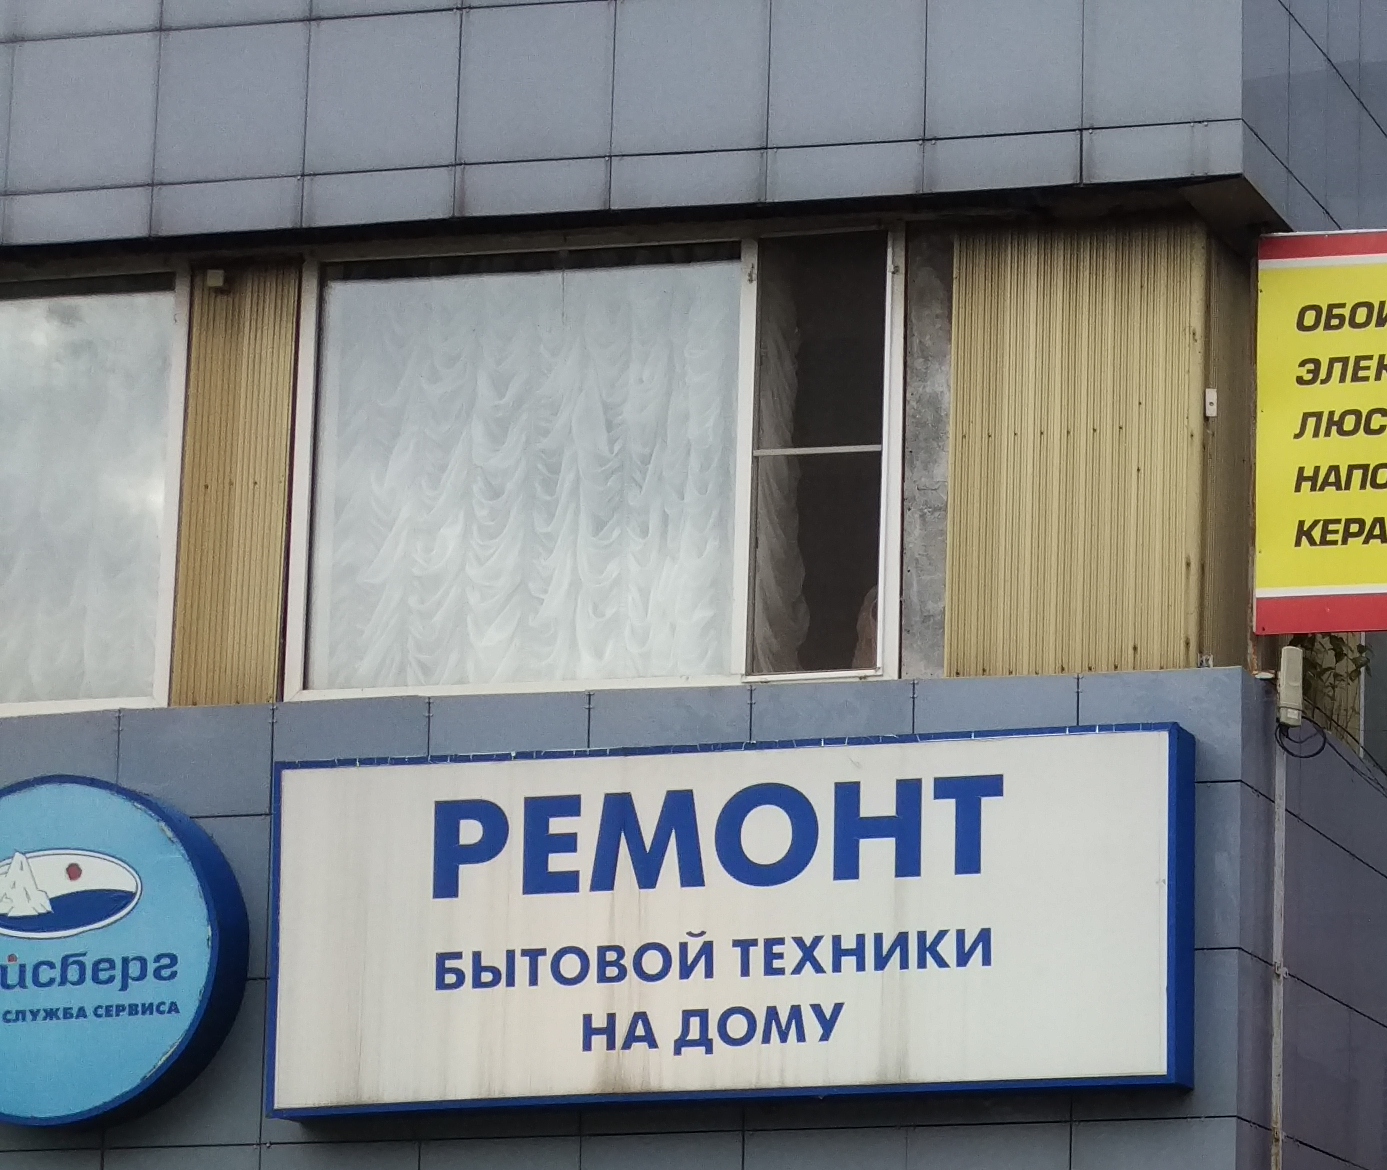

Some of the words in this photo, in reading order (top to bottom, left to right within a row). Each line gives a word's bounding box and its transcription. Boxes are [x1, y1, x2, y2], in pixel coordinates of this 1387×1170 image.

[432, 773, 1004, 900] РЕМОНТ
[435, 930, 714, 992] БЫТОВОЙ
[731, 927, 992, 978] ТЕХНИКИ
[2, 1005, 88, 1024] СЛУЖБА
[92, 1000, 181, 1019] СЕРВИСА
[581, 1010, 659, 1053] НА
[673, 1001, 845, 1056] ДОМУ
